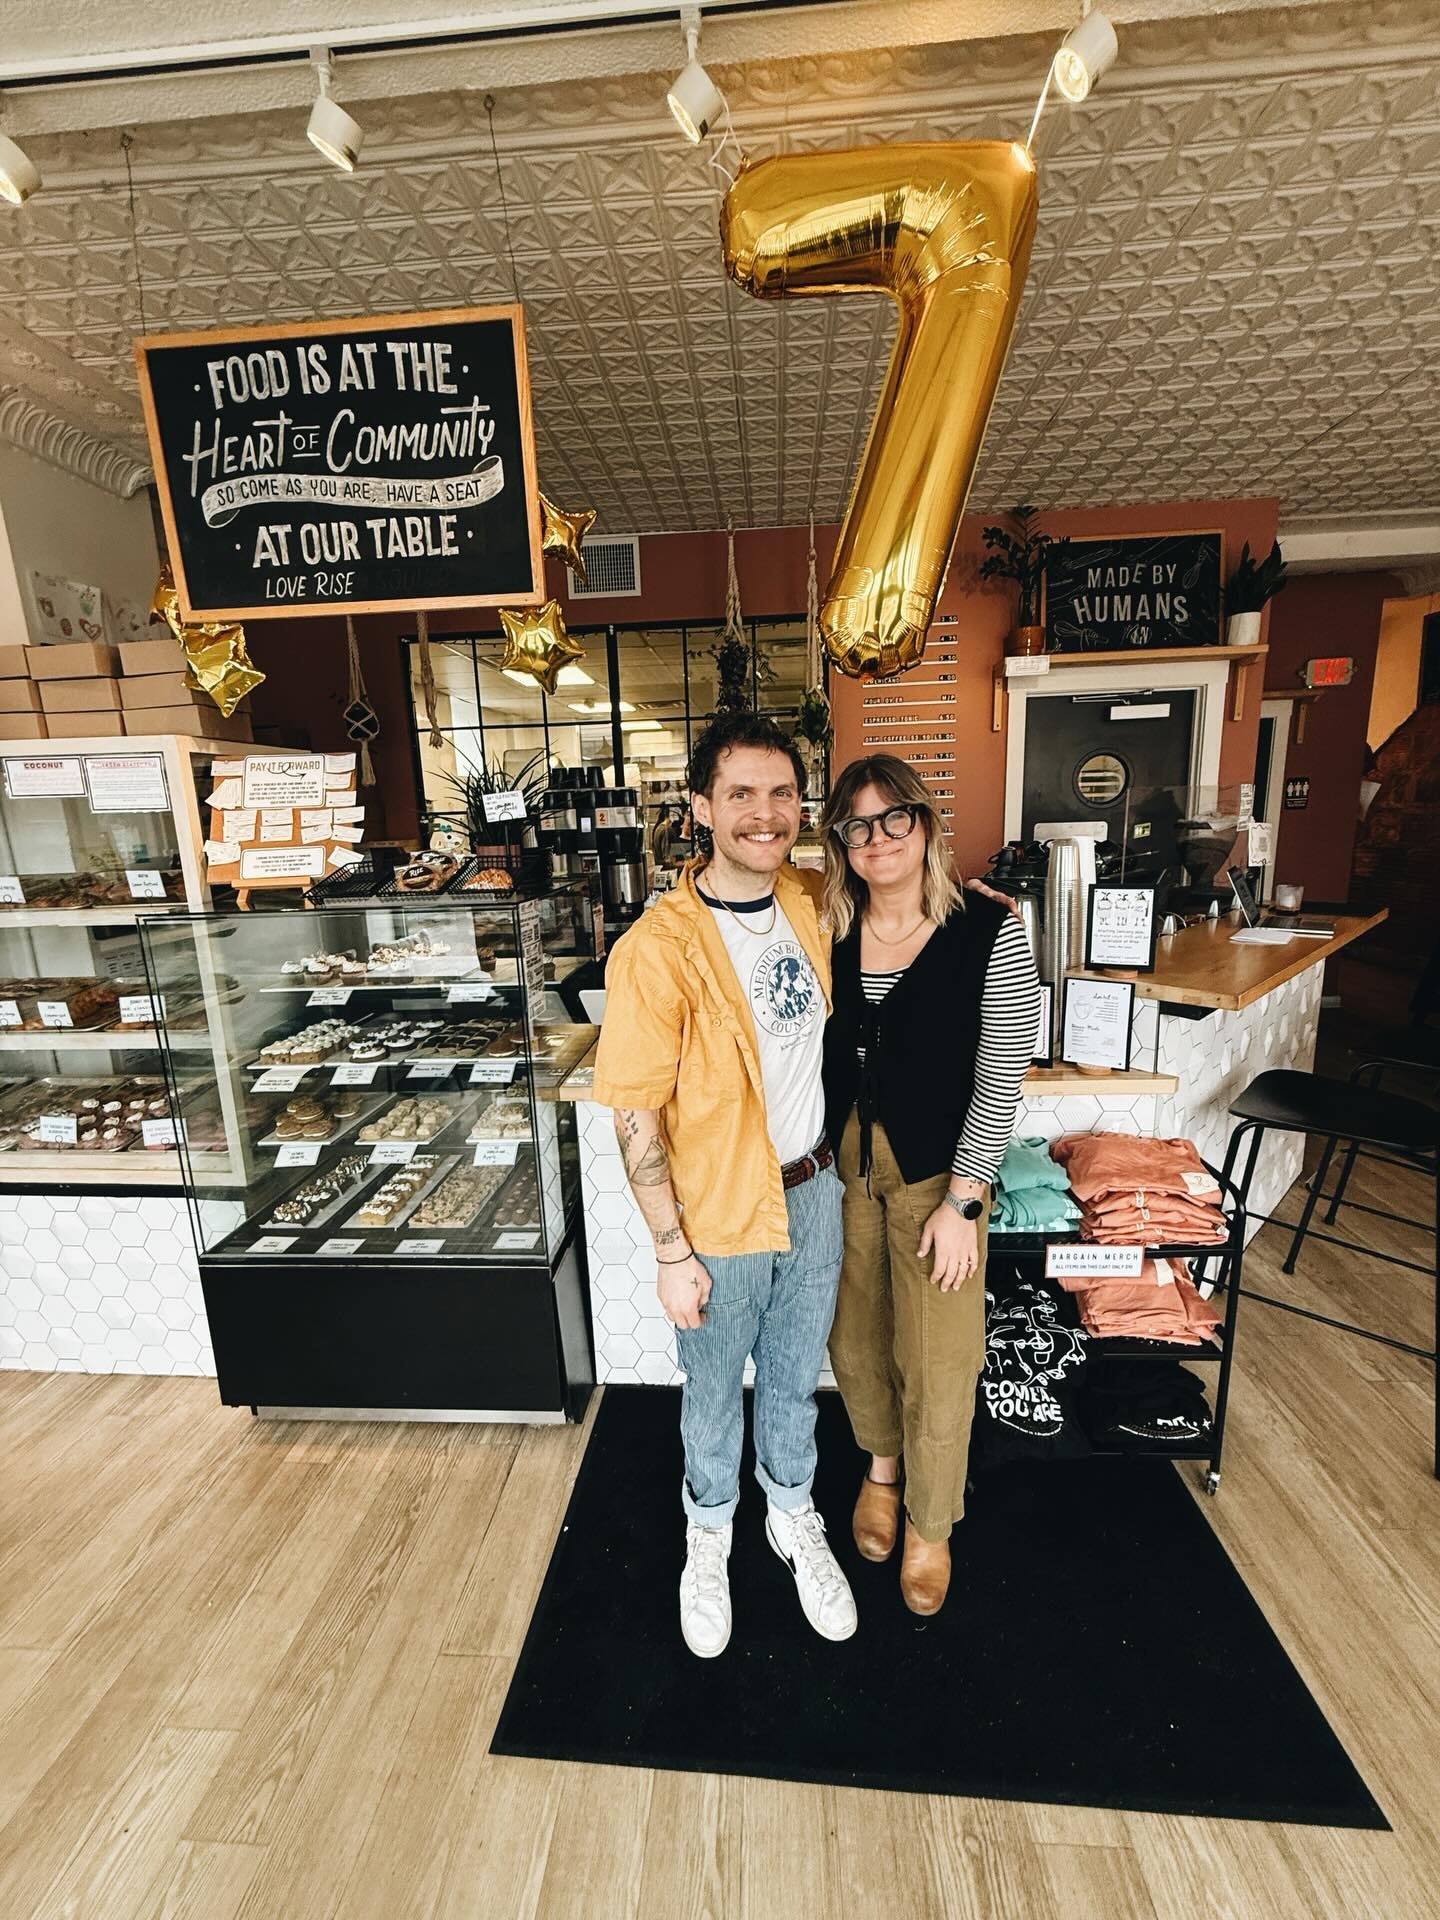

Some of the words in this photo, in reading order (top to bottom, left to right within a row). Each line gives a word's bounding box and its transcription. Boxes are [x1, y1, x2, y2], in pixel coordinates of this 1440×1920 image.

[208, 350, 290, 409] FOOD
[297, 343, 331, 395] IS
[339, 343, 378, 392] AT
[386, 342, 458, 395] THE
[292, 429, 320, 452] OF
[217, 486, 235, 506] SO
[240, 480, 279, 499] COME
[285, 478, 303, 496] AS
[310, 480, 337, 498] YOU
[343, 482, 378, 503] ARE,
[386, 484, 425, 502] HAVE
[429, 484, 441, 502] A
[446, 479, 481, 502] SEAT
[252, 523, 292, 568] AT
[300, 520, 361, 565] OUR
[366, 515, 460, 559] TABLE
[265, 576, 306, 599] LOVE
[314, 571, 356, 596] RISE
[1087, 563, 1148, 589] MADE
[1152, 563, 1177, 585] BY
[1073, 592, 1189, 625] HUMANS
[250, 763, 266, 772] PAY
[268, 762, 276, 771] IT
[754, 944, 784, 999] MEDIUM
[770, 1001, 818, 1033] COUNTRY
[986, 1398, 1030, 1419] YOU
[1032, 1403, 1064, 1423] ARE
